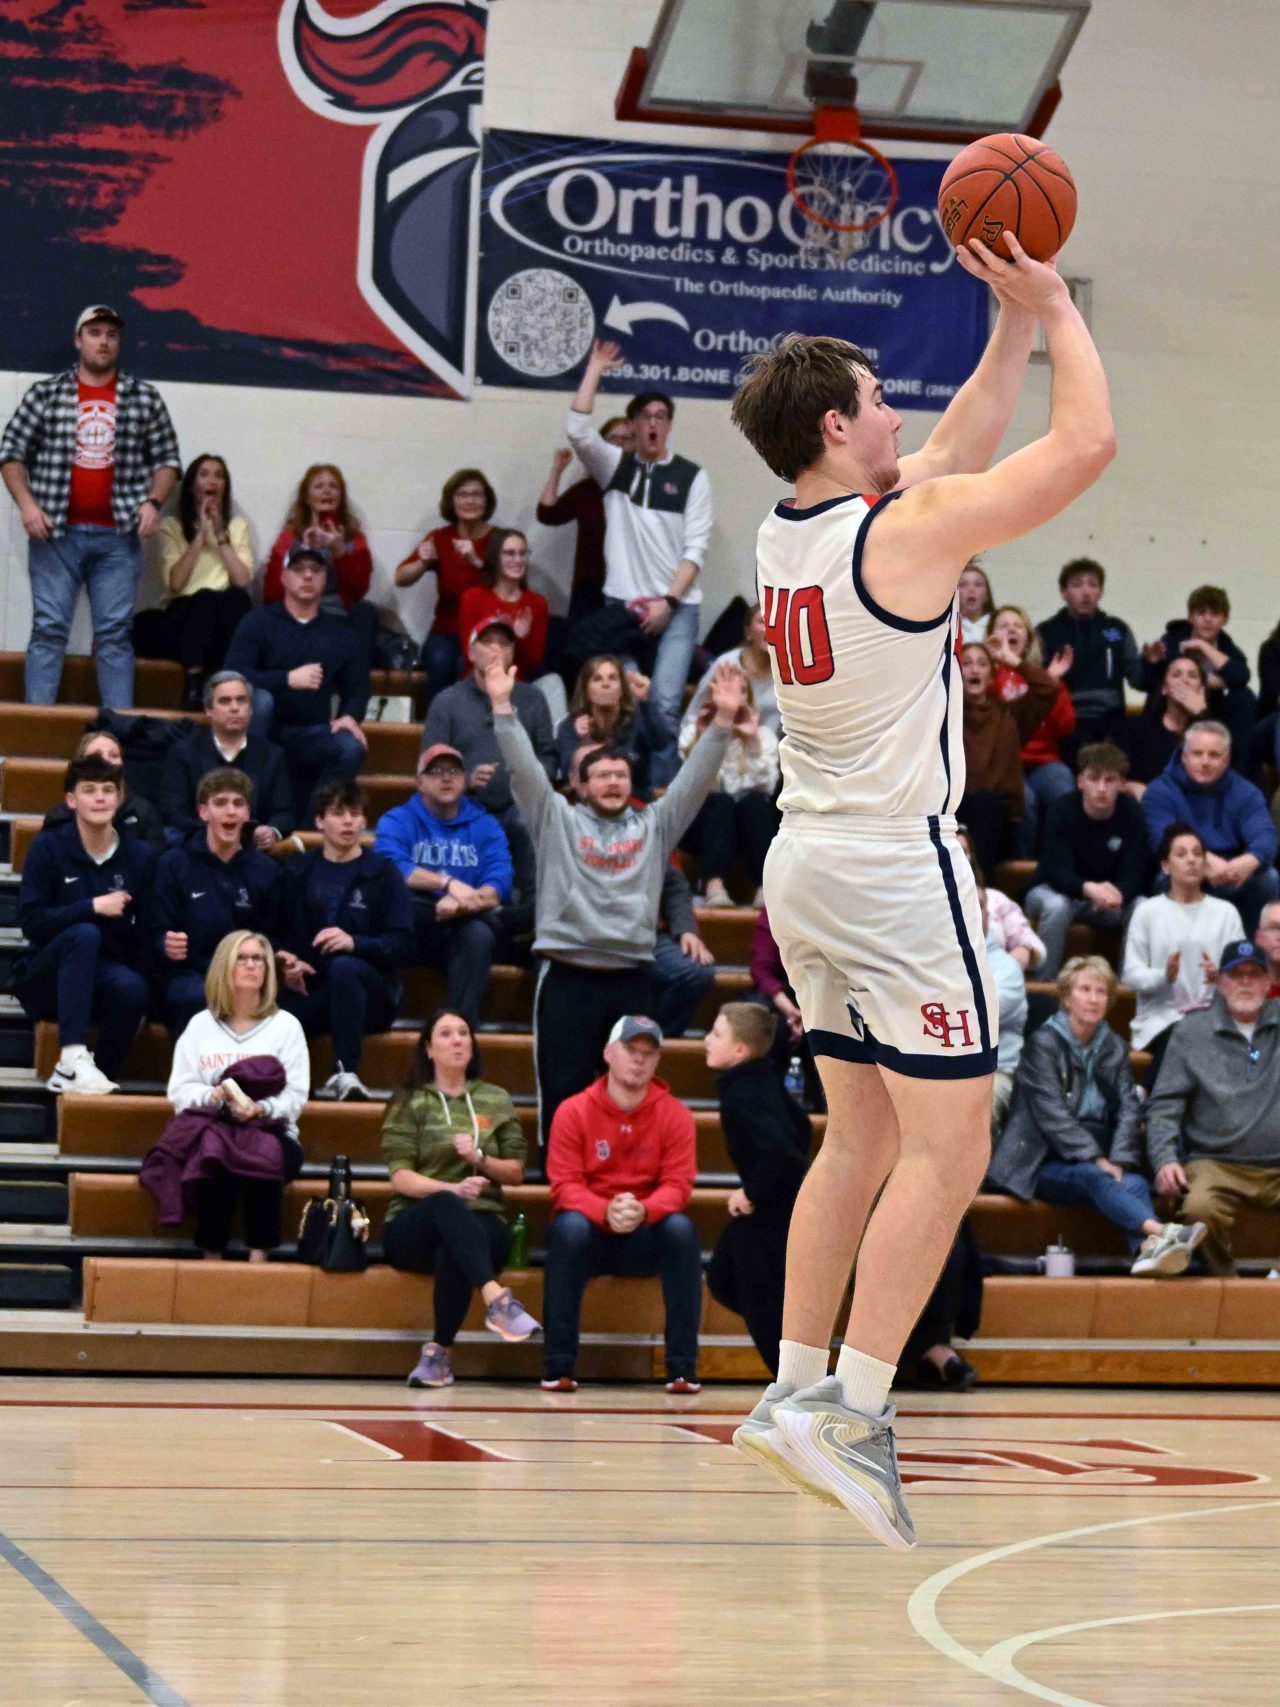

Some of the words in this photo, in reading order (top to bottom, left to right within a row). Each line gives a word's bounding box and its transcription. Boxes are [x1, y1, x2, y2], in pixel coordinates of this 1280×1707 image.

[562, 234, 716, 263] Orthopaedics
[721, 247, 740, 266] &
[746, 248, 818, 272] Sports
[824, 252, 926, 276] Medicine
[673, 277, 704, 294] The
[708, 280, 818, 301] Orthopaedic
[821, 287, 903, 308] Authority
[763, 584, 835, 686] 40
[201, 1052, 233, 1071] SAINT
